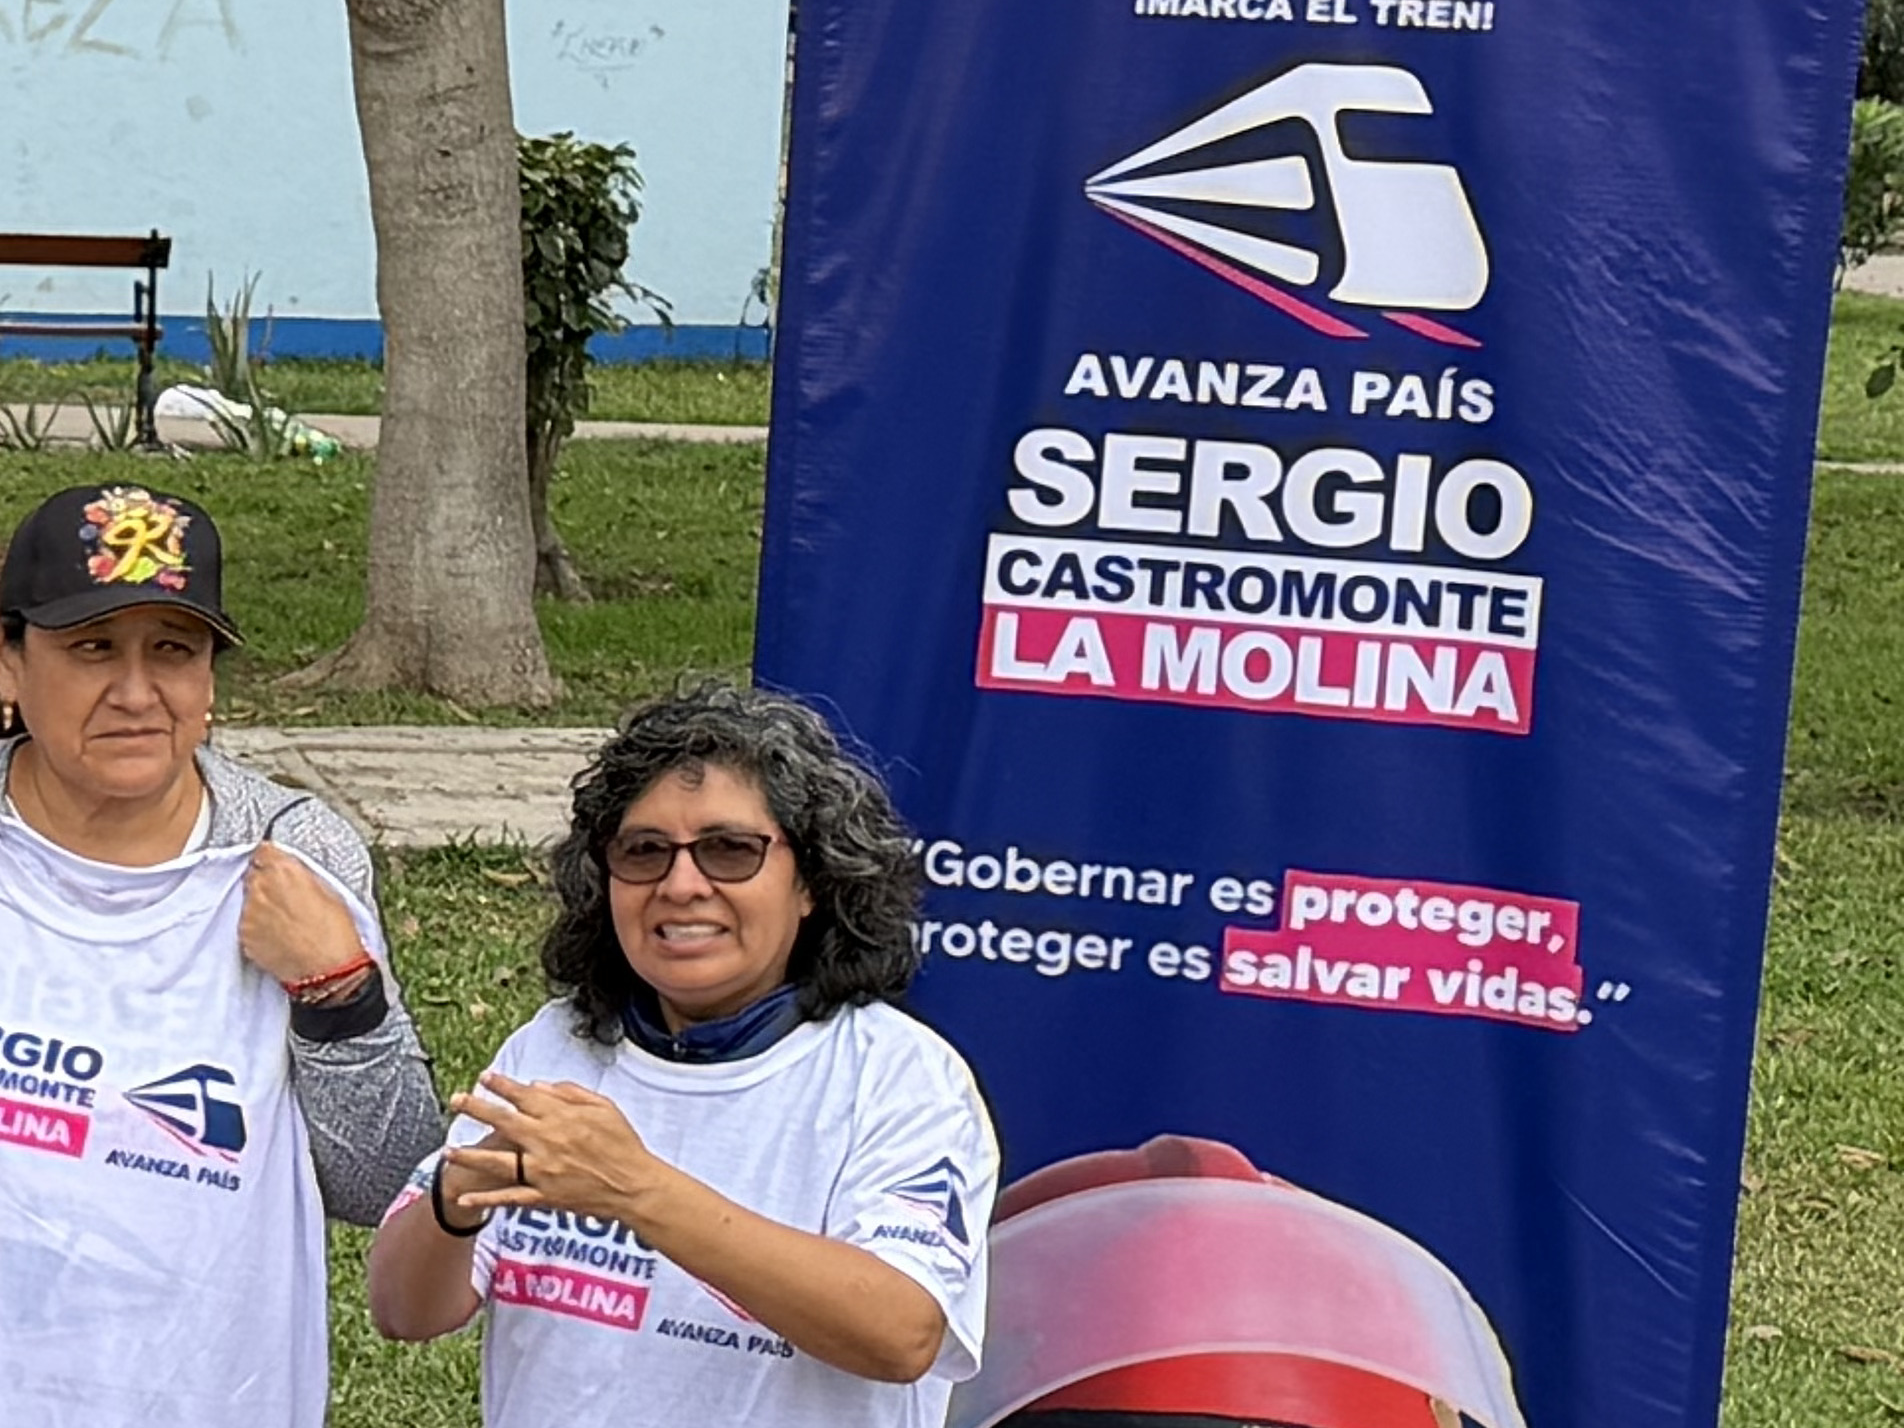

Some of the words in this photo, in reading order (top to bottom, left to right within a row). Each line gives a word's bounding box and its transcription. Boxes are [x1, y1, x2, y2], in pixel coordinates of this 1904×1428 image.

[1063, 352, 1328, 412] AVANZA
[1350, 366, 1495, 425] PAÍS
[1006, 426, 1534, 561] SERGIO
[995, 548, 1528, 636] CASTROMONTE
[990, 611, 1117, 688] LA
[1140, 621, 1521, 724] MOLINA
[1208, 876, 1275, 916] es
[1289, 883, 1566, 955] proteger,
[1147, 941, 1212, 981] es
[1224, 944, 1412, 1002] salvar
[105, 1149, 191, 1182] AVANZA
